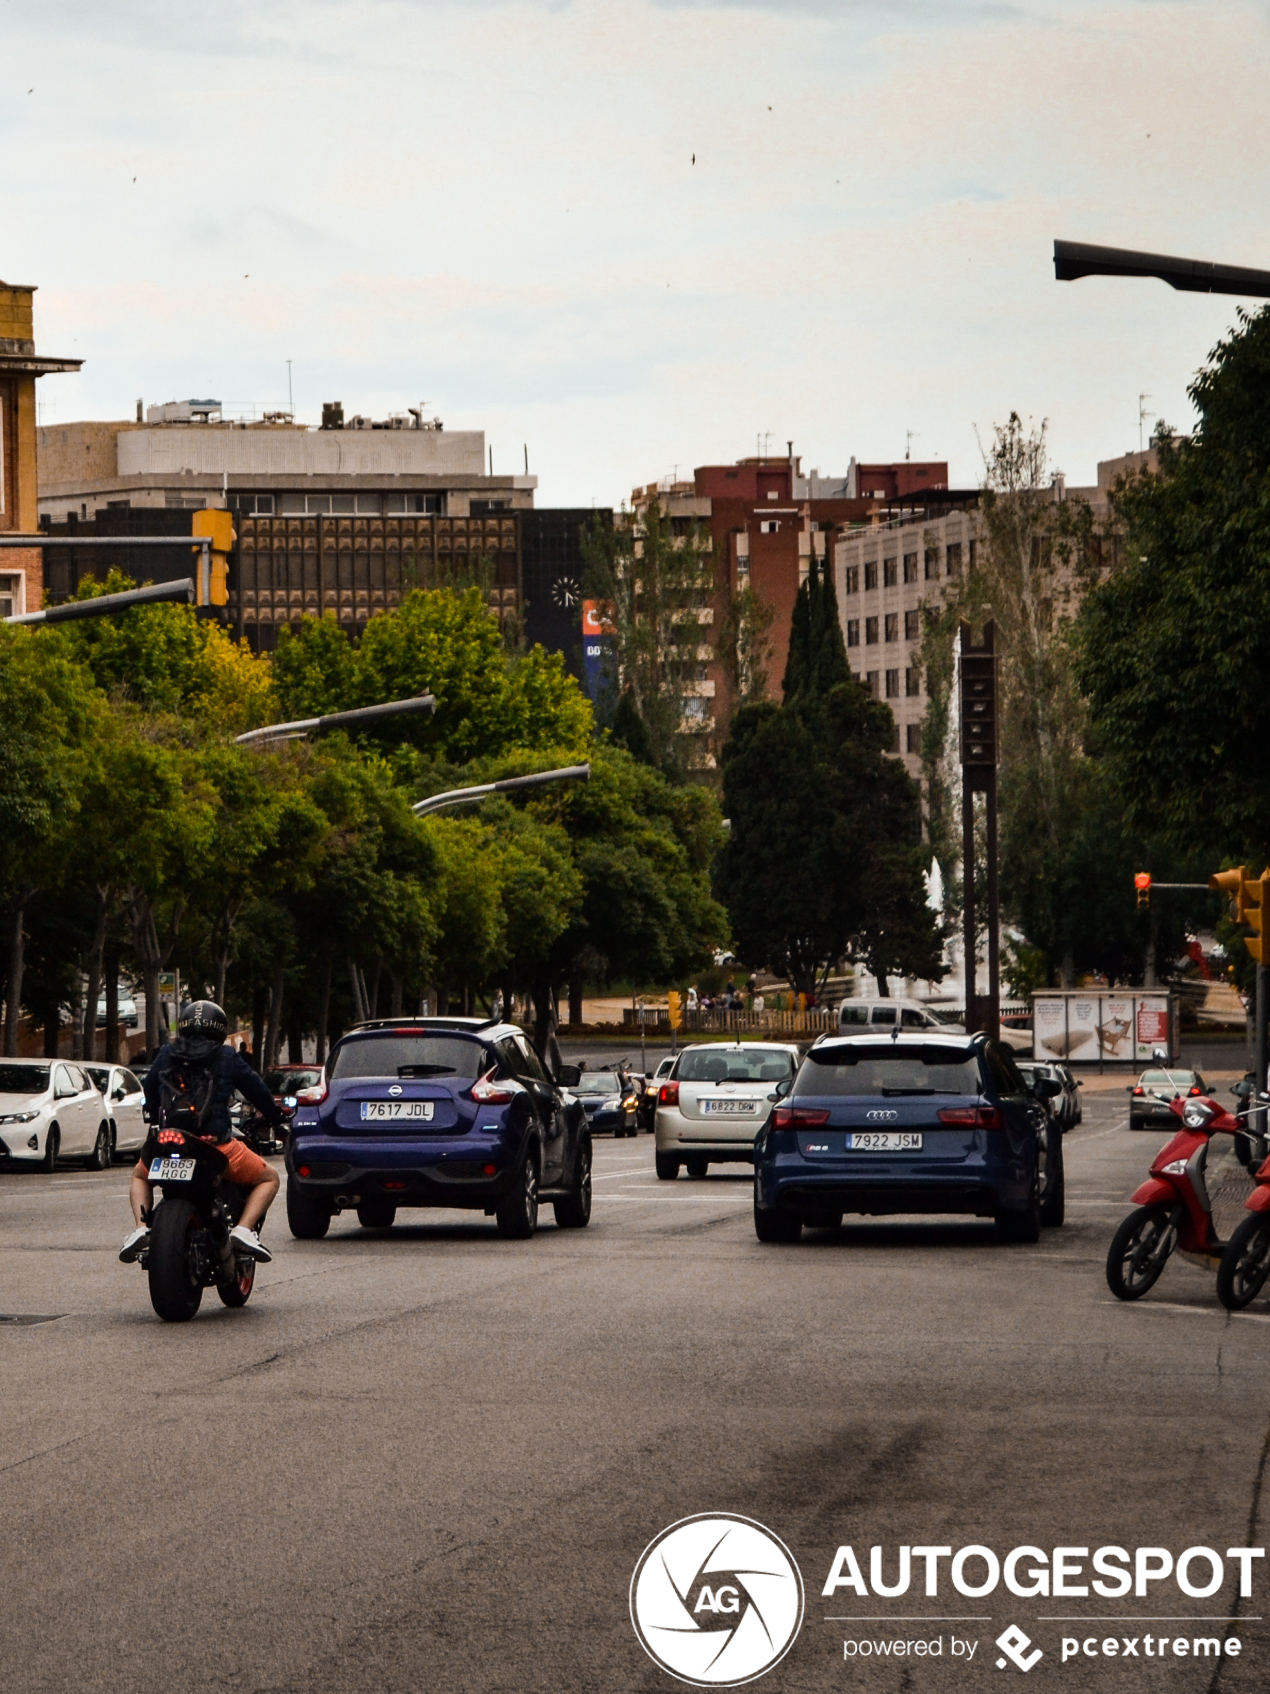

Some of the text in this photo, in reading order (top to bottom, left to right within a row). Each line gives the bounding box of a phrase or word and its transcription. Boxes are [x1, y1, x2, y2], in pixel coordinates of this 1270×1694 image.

[369, 1104, 430, 1116] 7617 JDL
[711, 1101, 735, 1111] 6822
[854, 1134, 920, 1147] 7922 JSM
[162, 1159, 193, 1169] 9663
[161, 1169, 187, 1178] HGG
